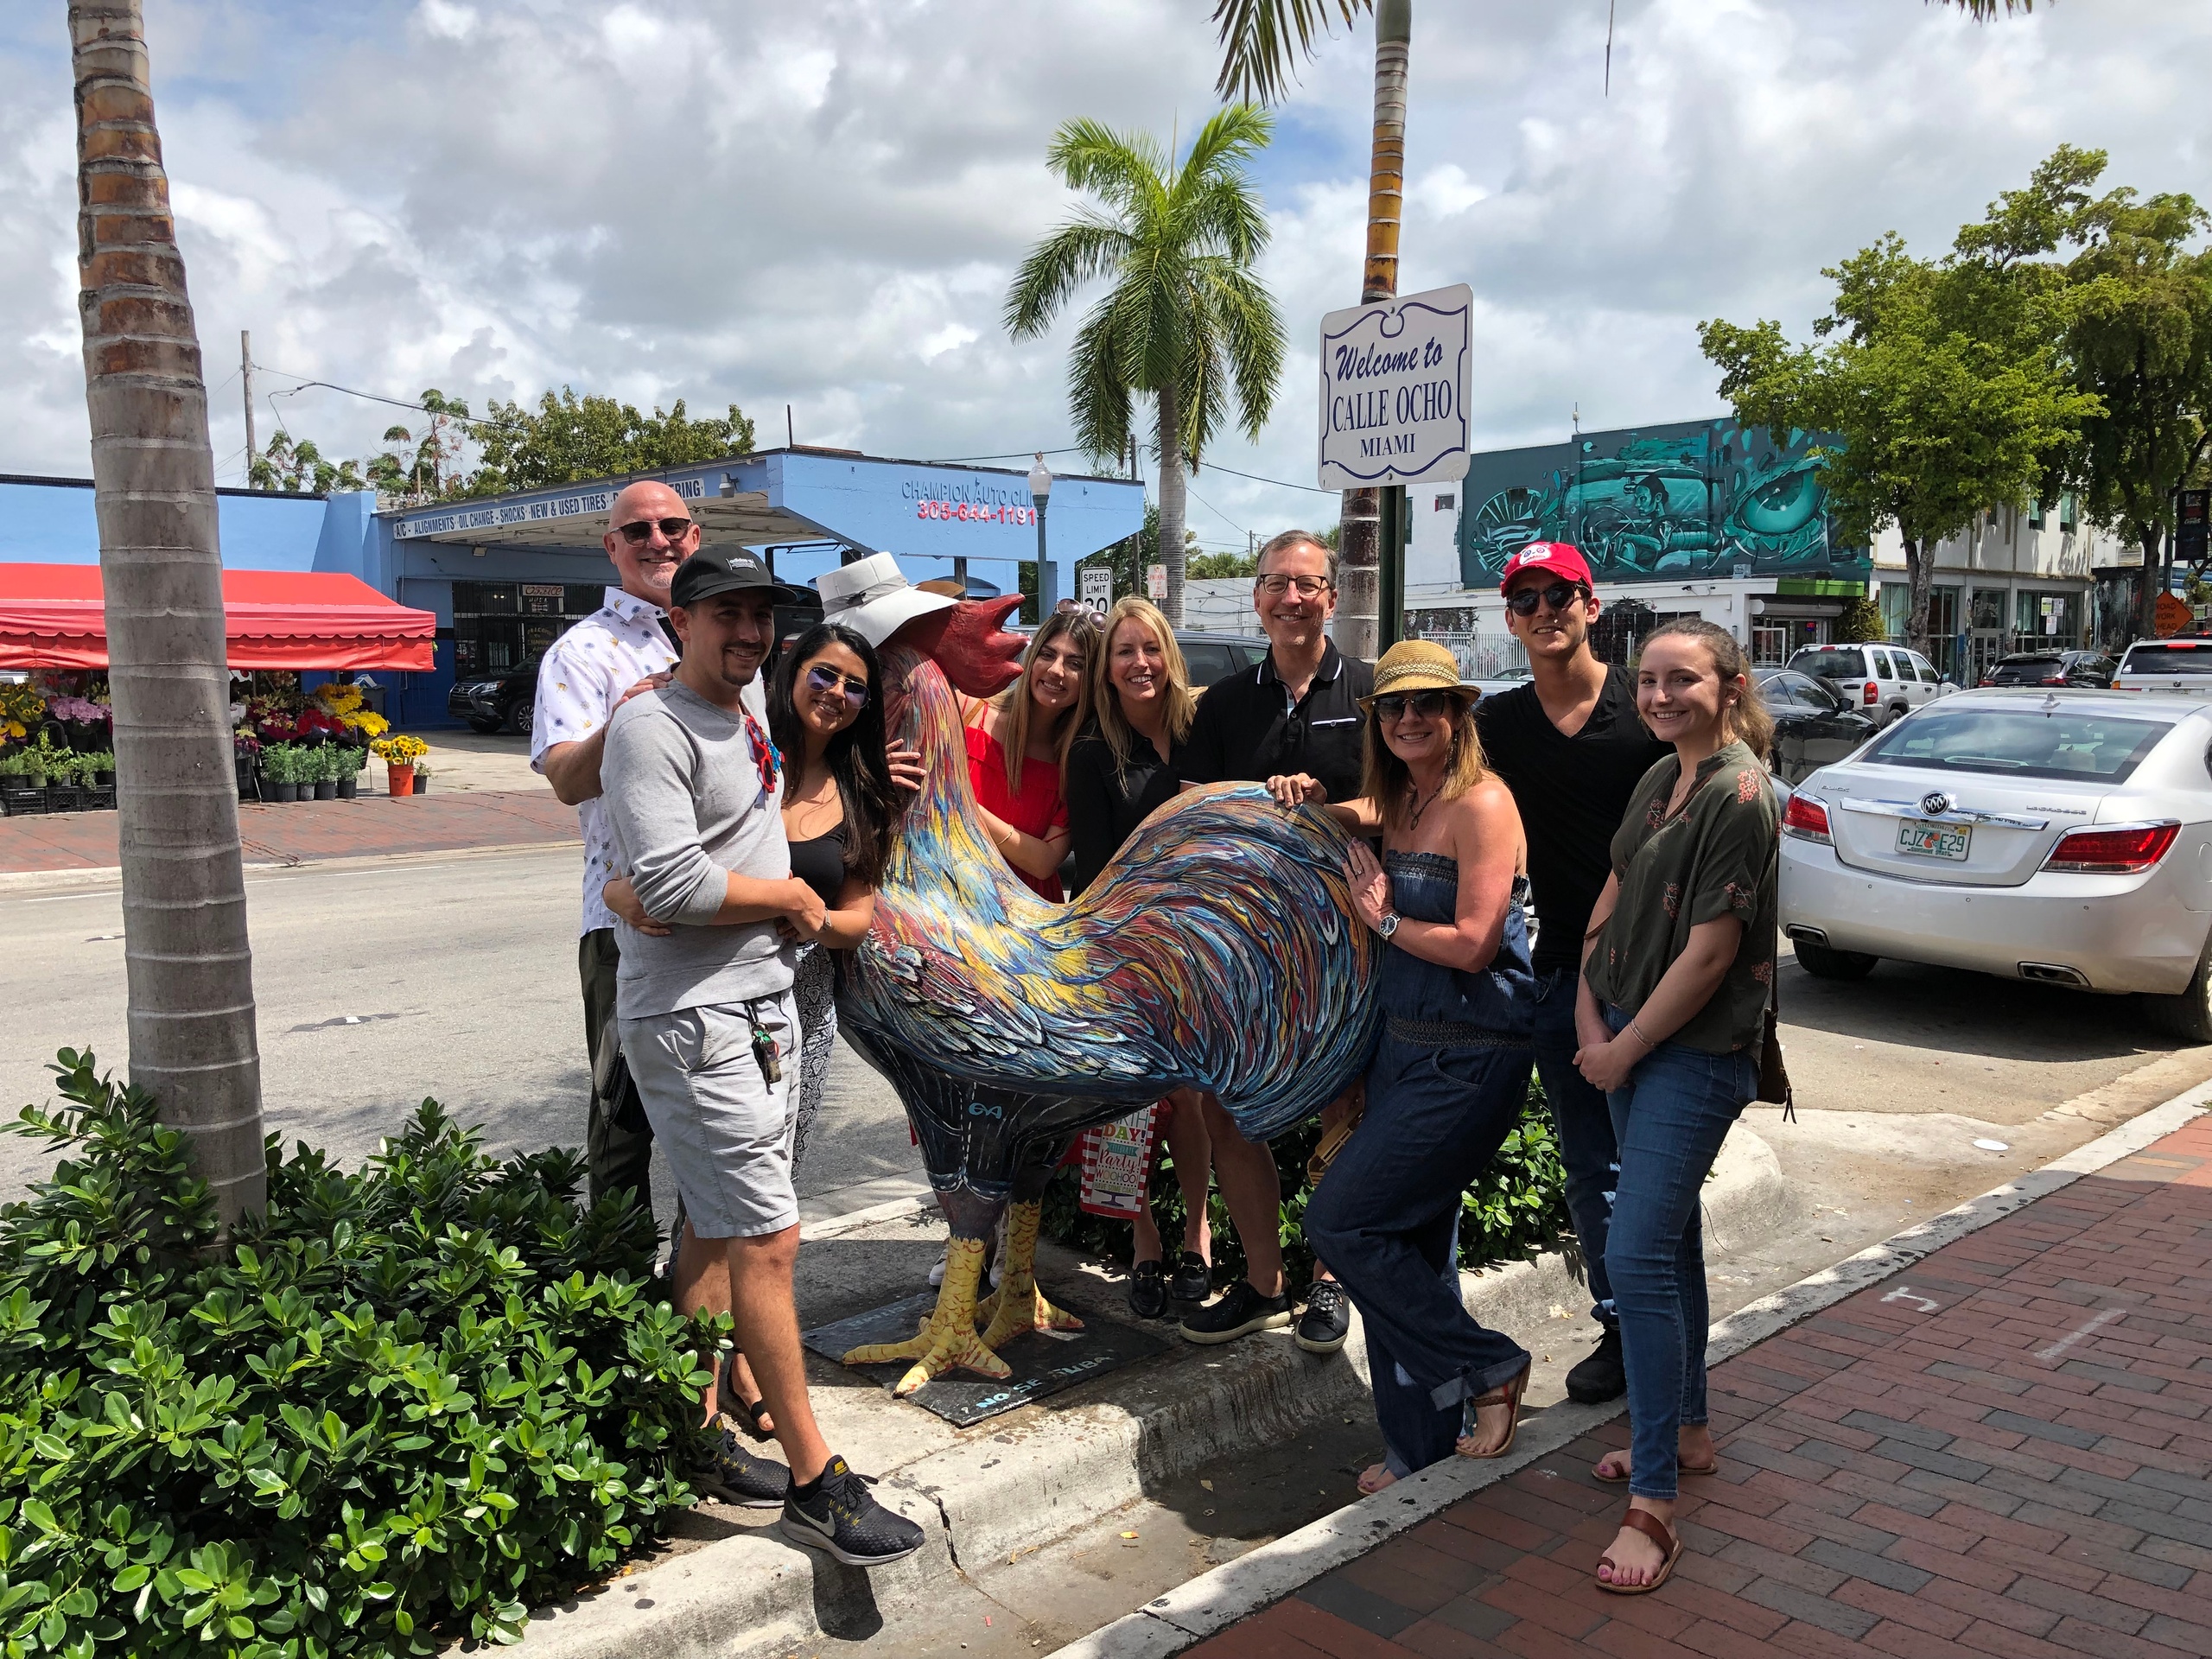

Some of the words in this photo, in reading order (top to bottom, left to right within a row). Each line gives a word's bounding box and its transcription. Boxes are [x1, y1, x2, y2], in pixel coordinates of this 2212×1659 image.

[1336, 342, 1418, 382] Welcome
[1424, 336, 1443, 369] to
[1332, 389, 1389, 432] CALLE
[1396, 379, 1452, 424] OCHO
[1359, 433, 1415, 458] MIAMI
[901, 480, 969, 504] CHAMPION
[973, 485, 1007, 506] AUTO
[1010, 489, 1033, 507] CLI
[396, 523, 406, 537] A/C
[414, 516, 454, 535] ALIGNMENTS
[458, 515, 469, 529] OIL
[470, 511, 494, 527] CHANGE
[499, 505, 525, 524] SHOCKS
[531, 503, 548, 519] NEW
[550, 503, 557, 517] &
[559, 499, 580, 515] USED
[582, 493, 607, 512] TIRES
[917, 499, 1036, 526] 305-644-1191
[1084, 573, 1109, 582] SPEED
[1086, 585, 1106, 594] LIMIT
[1900, 829, 1925, 848] CJZ
[1939, 833, 1965, 852] E29
[1103, 1123, 1146, 1143] DAY!
[1100, 1149, 1142, 1174] Party!
[976, 1392, 1010, 1408] NO
